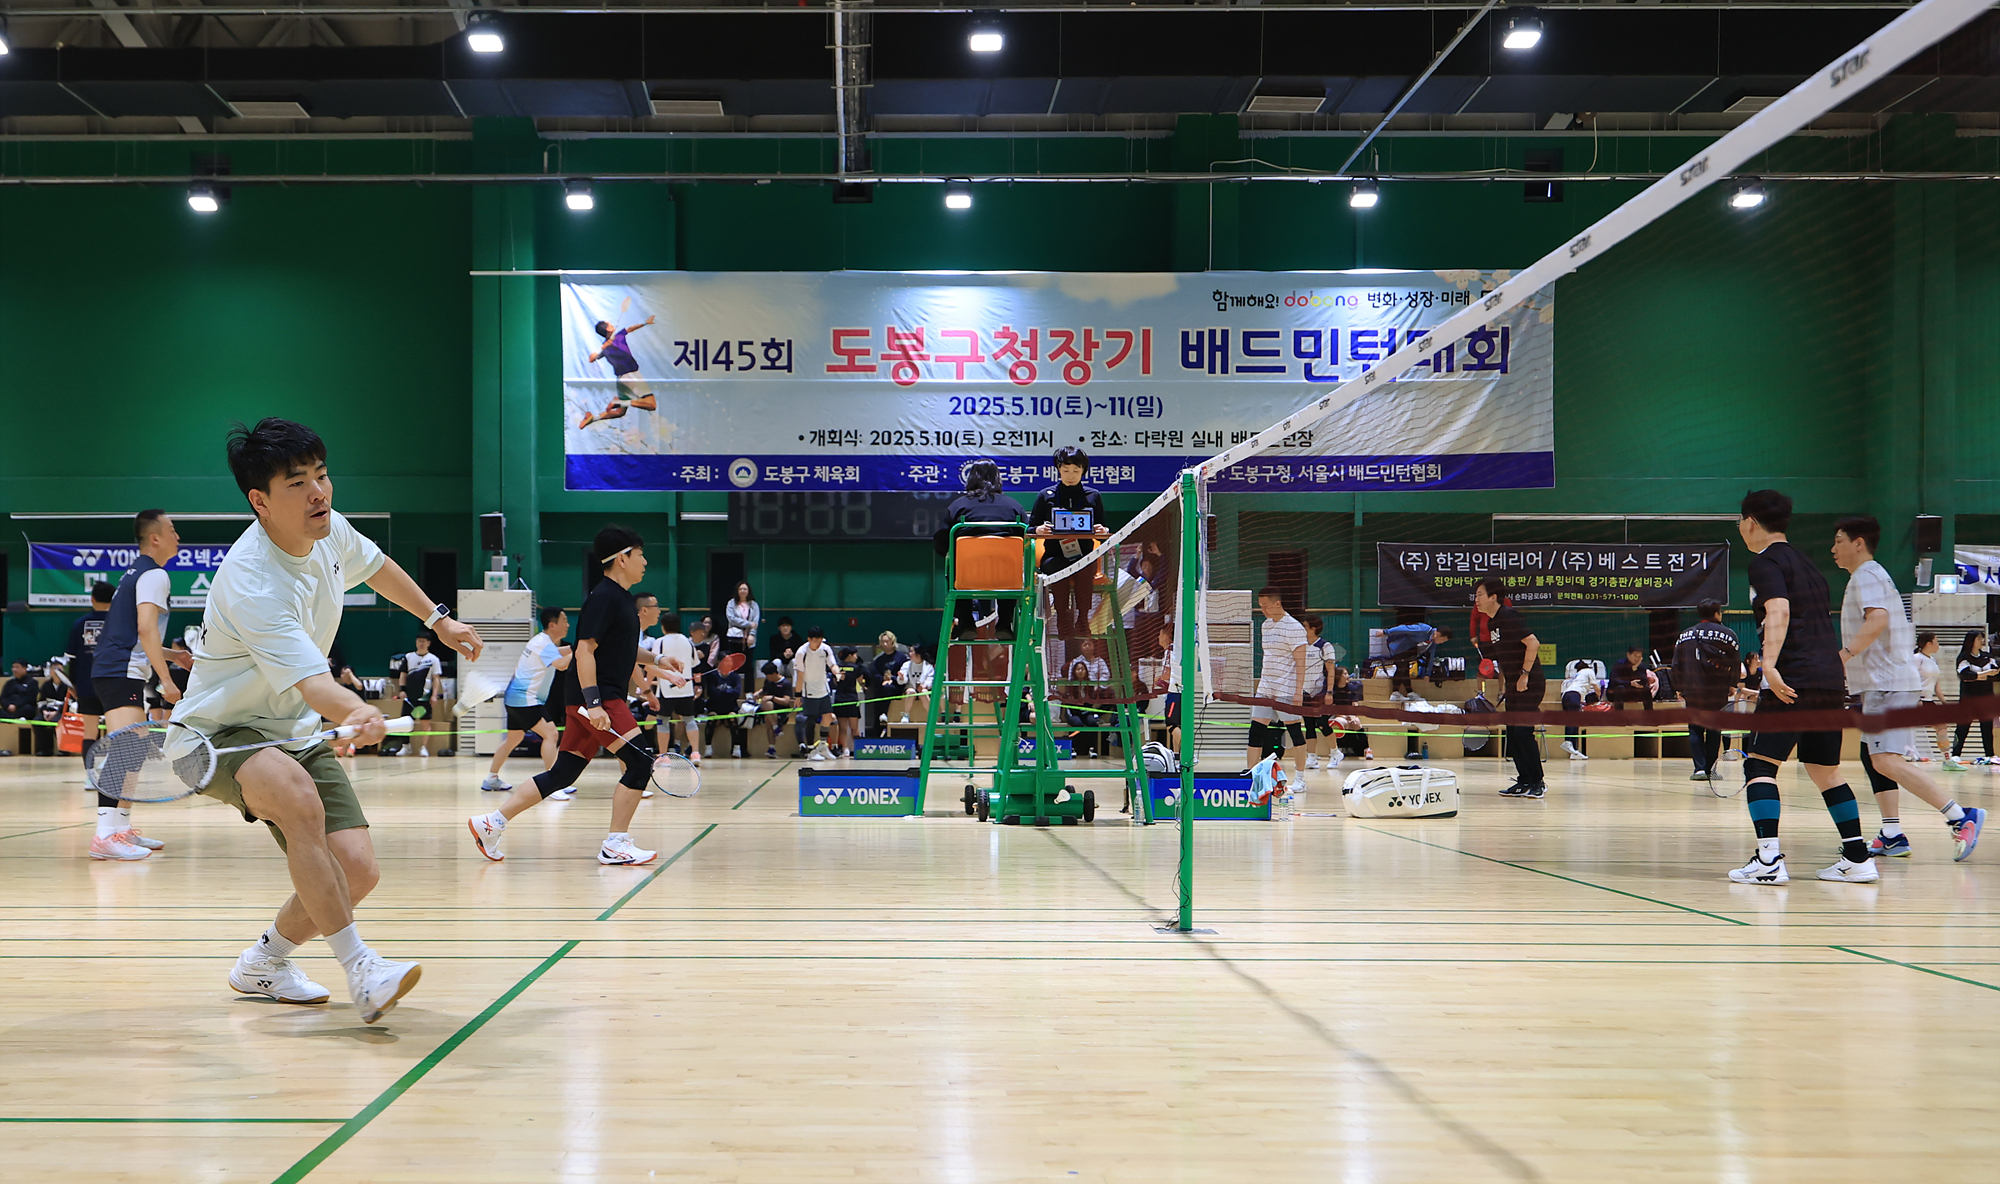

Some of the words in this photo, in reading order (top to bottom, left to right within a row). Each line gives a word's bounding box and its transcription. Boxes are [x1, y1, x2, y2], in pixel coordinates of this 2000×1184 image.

[1830, 48, 1870, 88] star
[1679, 156, 1709, 187] star
[1212, 290, 1279, 312] 함께해요!
[1284, 290, 1358, 311] dobong
[673, 337, 793, 373] 제45회
[825, 326, 1152, 386] 도봉구청장기
[949, 396, 1163, 419] 2025.5.10(토)~11(일)
[809, 429, 863, 447] 개회식:
[869, 429, 984, 449] 2025.5.10(토)
[991, 430, 1054, 448] 오전11시
[1134, 430, 1184, 448] 다락원
[1191, 430, 1223, 448] 실내
[763, 466, 811, 484] 도봉구
[813, 466, 860, 483] 체육회
[1298, 465, 1344, 483] 서울시
[1348, 464, 1442, 483] 배드민턴협회
[1399, 551, 1430, 571] (주)
[1435, 551, 1543, 572] 한길인테리어
[1562, 551, 1593, 571] (주)
[1535, 576, 1586, 588] 블루밍비데
[1585, 593, 1640, 601] 031-571-1800
[878, 744, 906, 755] YONEX
[846, 787, 900, 805] YONEX
